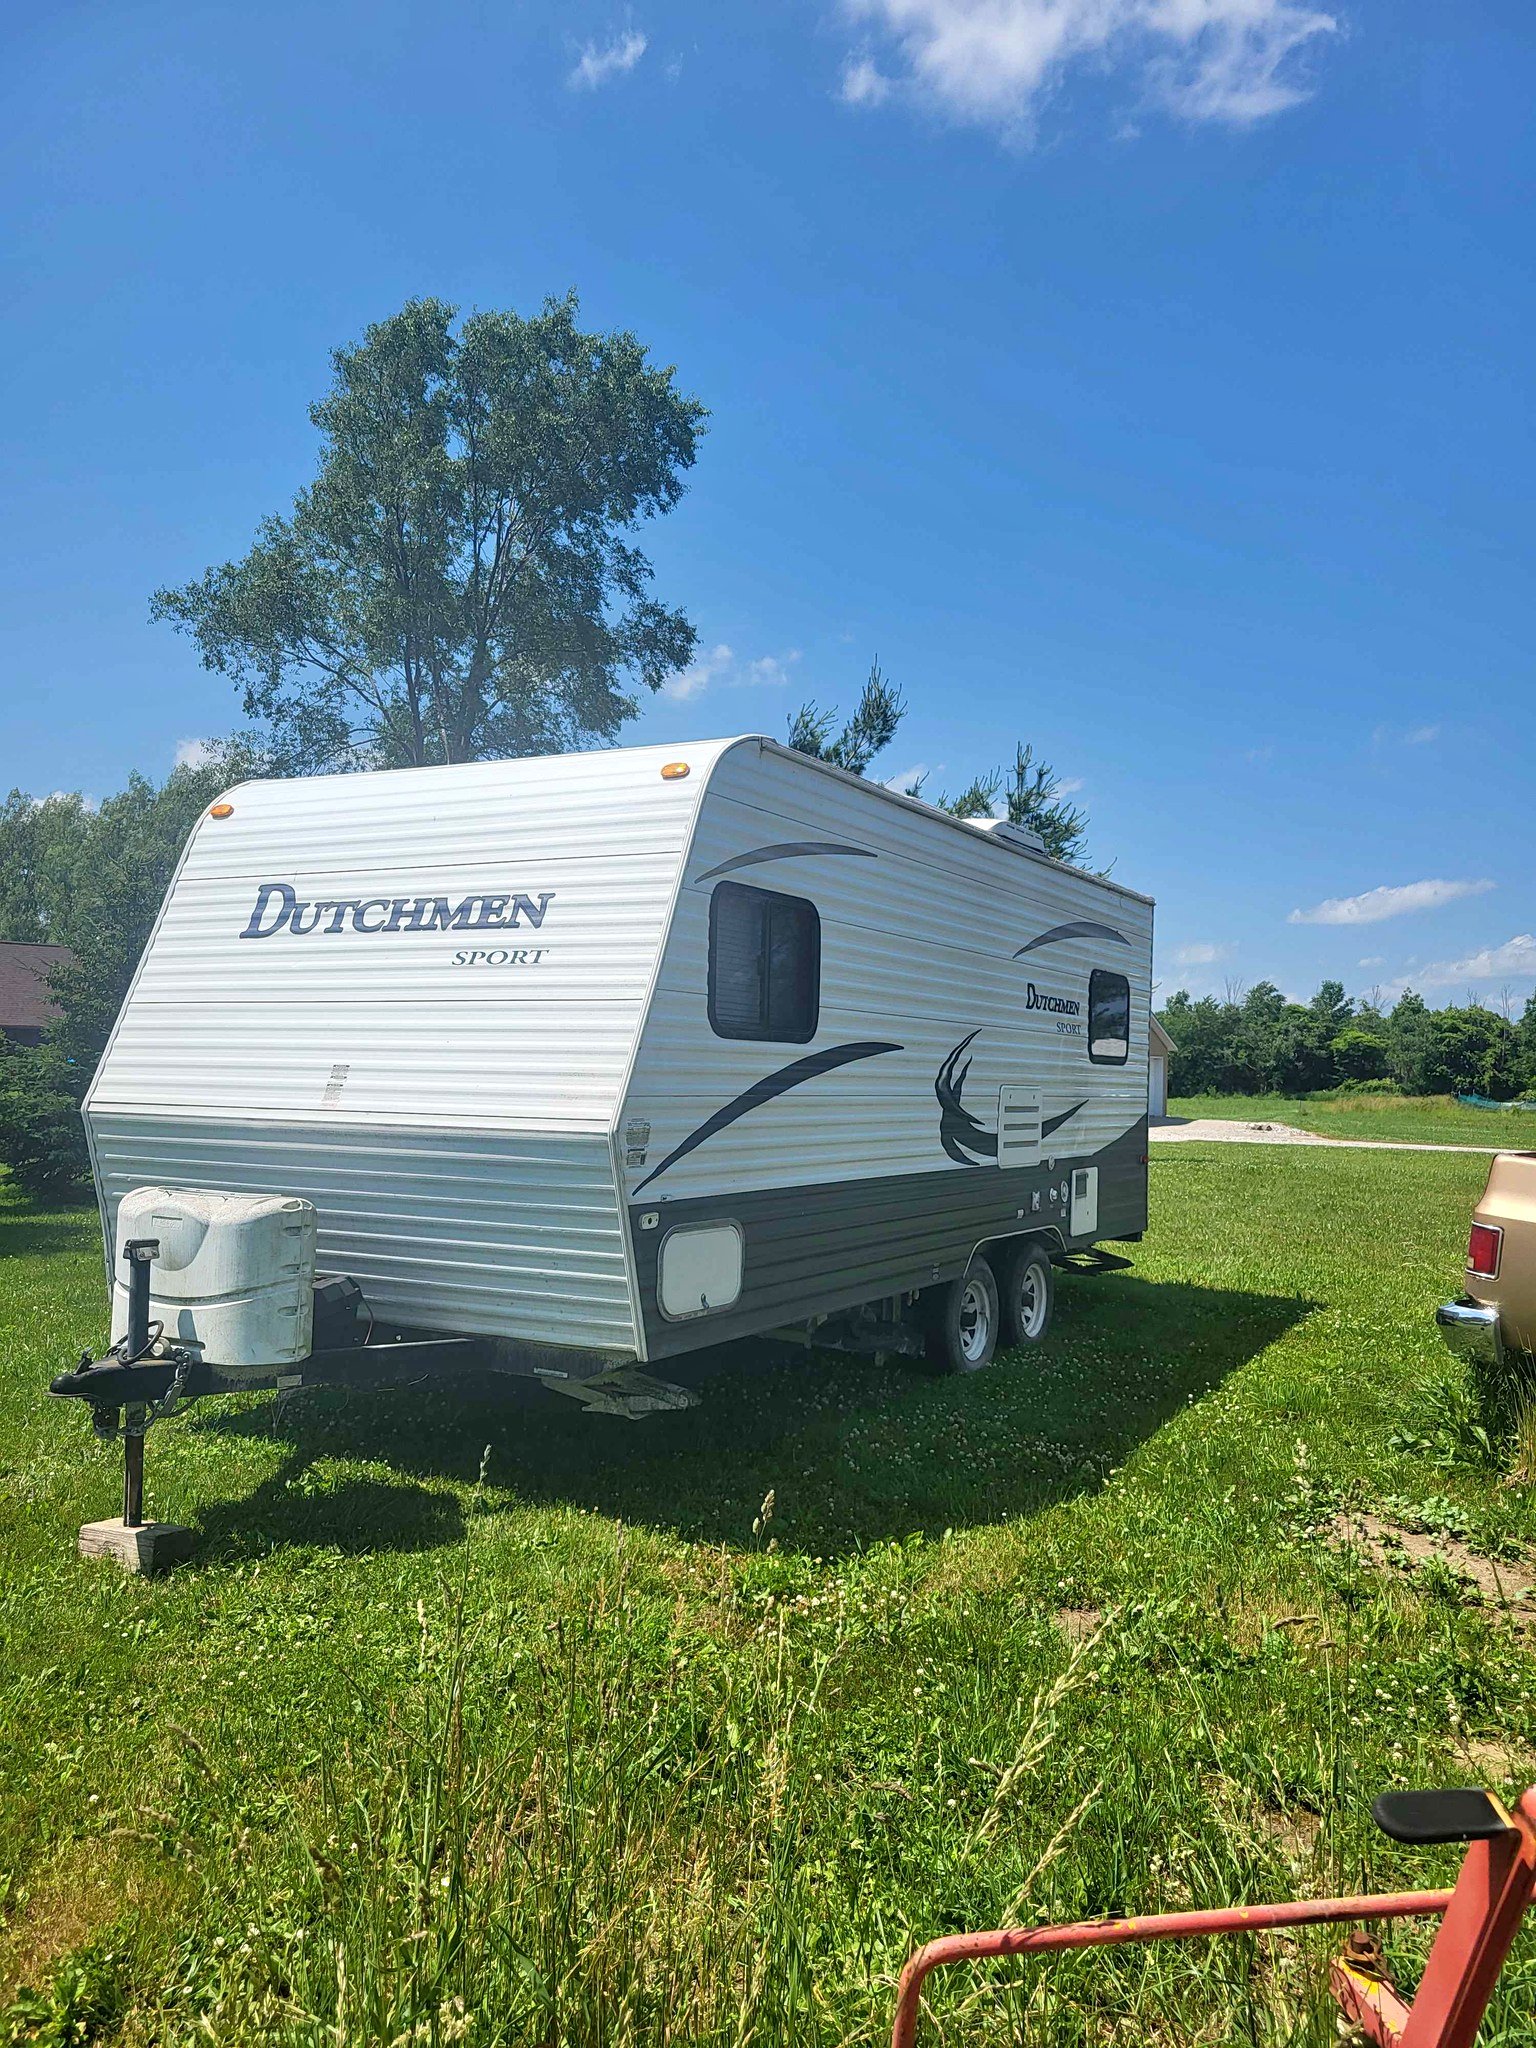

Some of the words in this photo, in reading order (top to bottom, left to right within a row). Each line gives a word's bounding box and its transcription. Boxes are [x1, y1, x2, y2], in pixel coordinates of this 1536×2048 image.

[239, 883, 556, 938] DUTCHMEN
[451, 949, 550, 965] SPORT
[1026, 983, 1080, 1016] DUTCHMEN
[1056, 1021, 1082, 1035] SPORT
